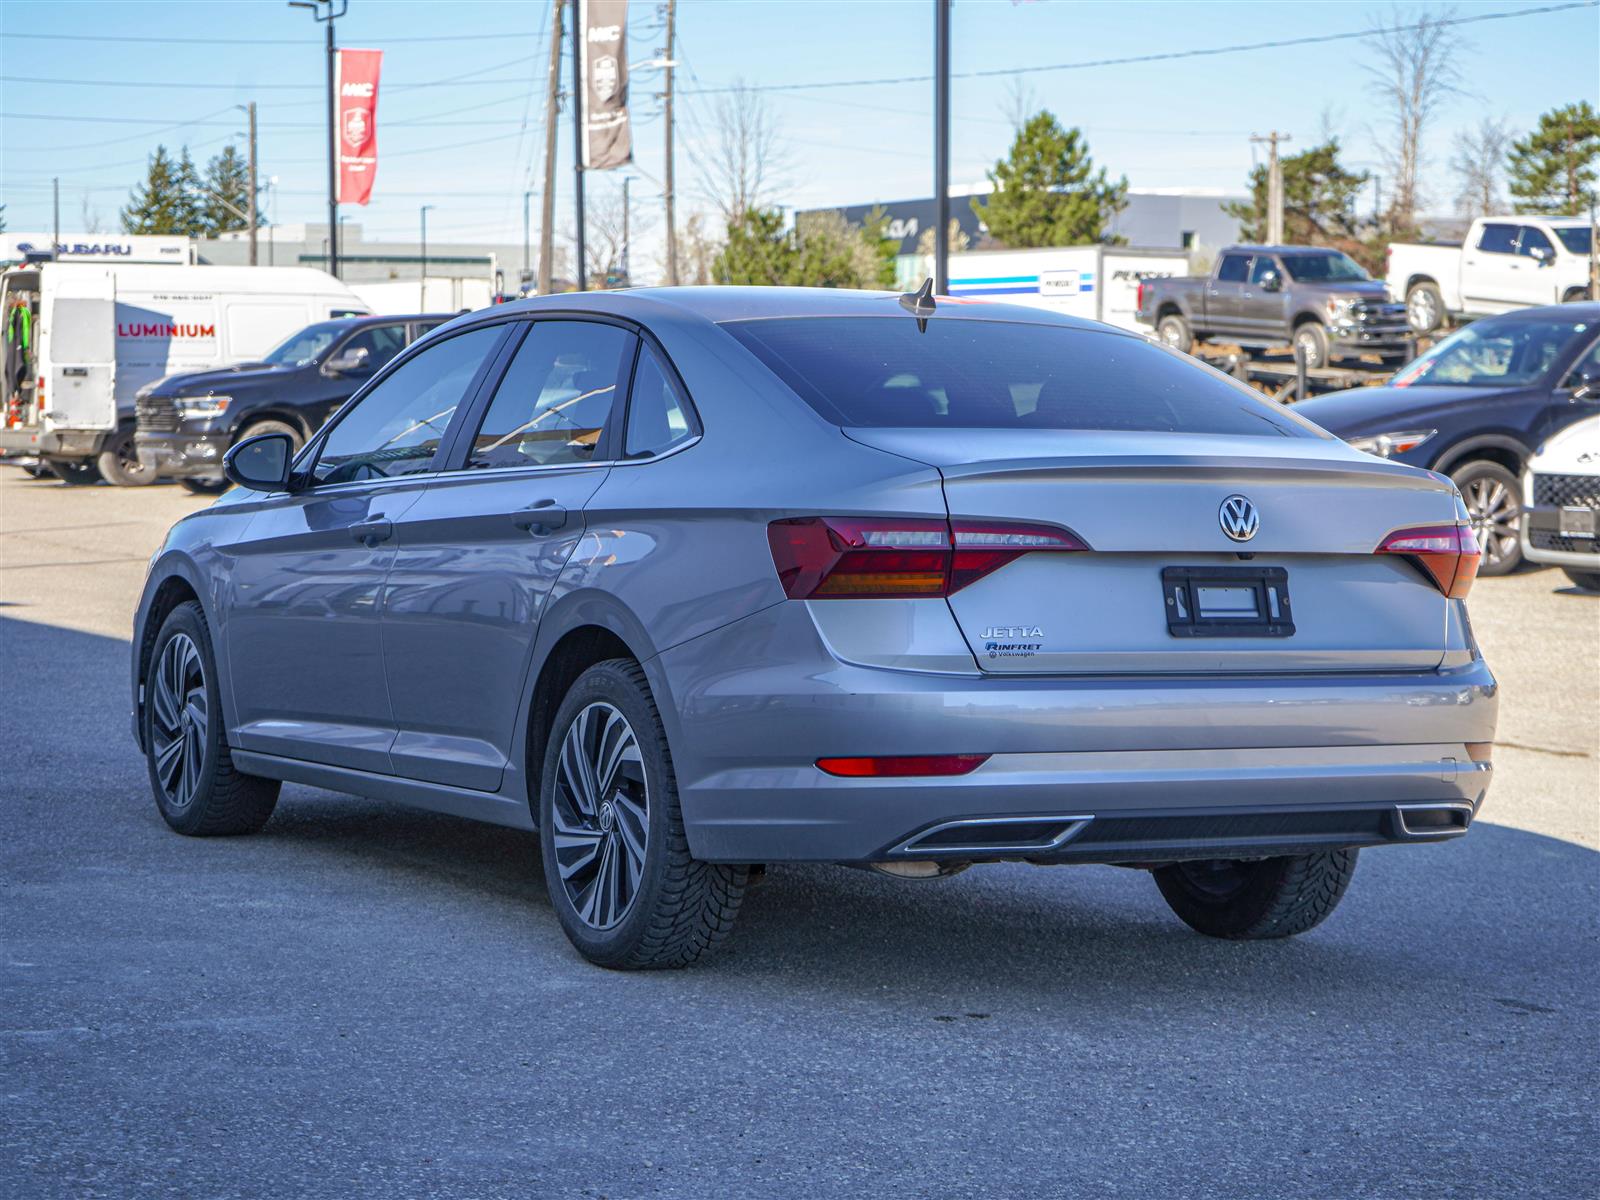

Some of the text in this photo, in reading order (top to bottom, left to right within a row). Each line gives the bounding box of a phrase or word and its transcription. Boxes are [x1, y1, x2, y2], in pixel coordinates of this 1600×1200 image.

[56, 243, 131, 256] SUBARU
[980, 626, 1044, 638] JETTA
[985, 641, 1042, 651] RINFRET
